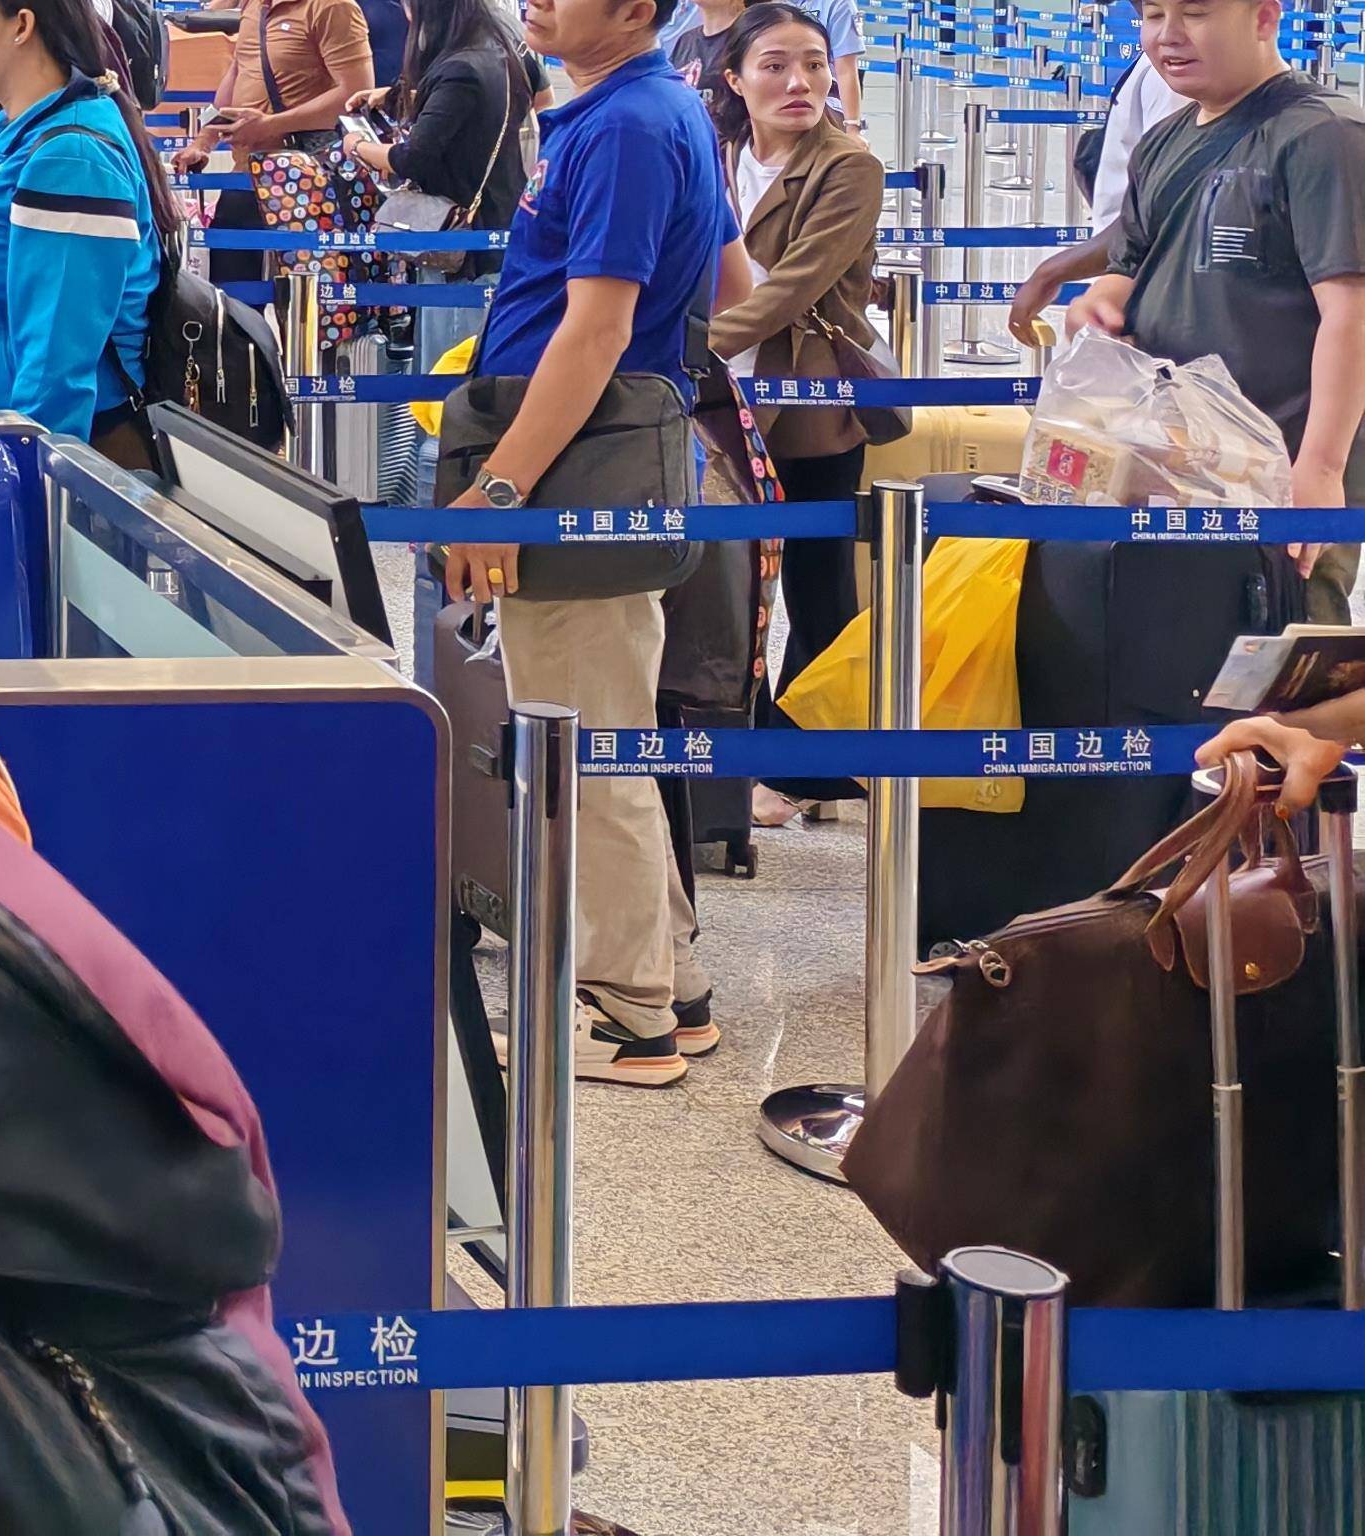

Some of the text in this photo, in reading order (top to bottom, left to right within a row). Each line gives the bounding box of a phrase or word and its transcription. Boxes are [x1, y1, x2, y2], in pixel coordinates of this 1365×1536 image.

[319, 232, 376, 245] 中国边检
[935, 284, 1017, 299] 中国边检
[754, 379, 855, 398] 中国边检
[558, 508, 685, 531] 中国边检
[1131, 508, 1259, 531] 中国边检
[590, 731, 713, 761] 国边检
[982, 729, 1151, 762] 中国边检
[650, 763, 713, 774] INSPECTION
[984, 761, 1152, 775] CHINA IMMIGRATION INSPECTION
[292, 1315, 418, 1365] 边检
[314, 1368, 419, 1388] INSPECTION
